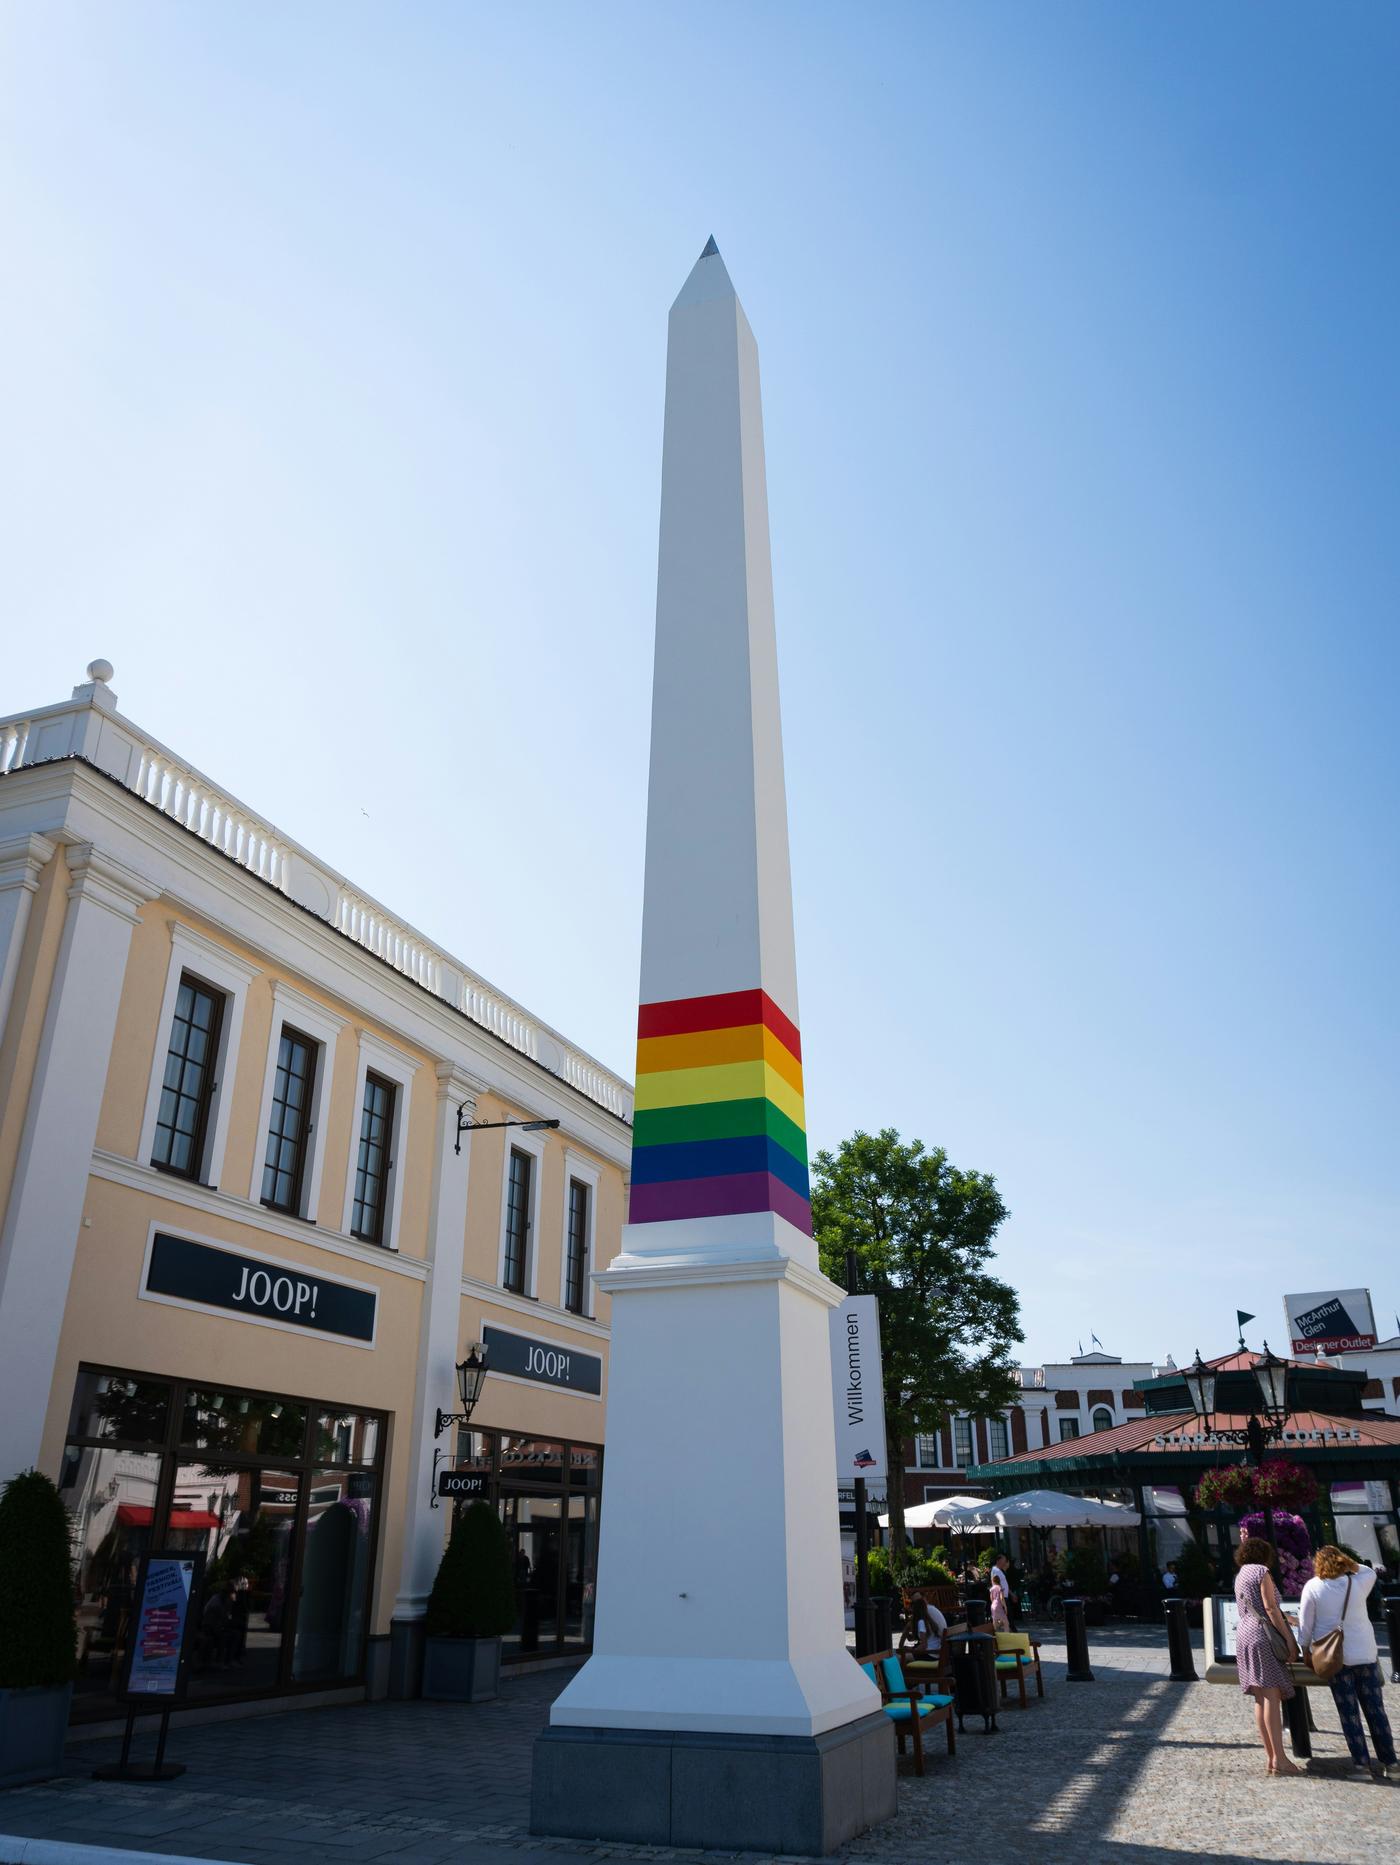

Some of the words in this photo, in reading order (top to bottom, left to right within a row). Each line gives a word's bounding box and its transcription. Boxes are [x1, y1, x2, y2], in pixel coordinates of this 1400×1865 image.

[232, 1267, 318, 1318] JOOP!
[1297, 1302, 1340, 1327] McArthur
[1303, 1322, 1326, 1337] Glen
[1340, 1338, 1371, 1348] Outlet
[525, 1346, 570, 1380] JOOP!
[846, 1313, 864, 1426] Willkommen
[1281, 1427, 1360, 1443] COFFEE
[444, 1478, 482, 1490] JOOP!
